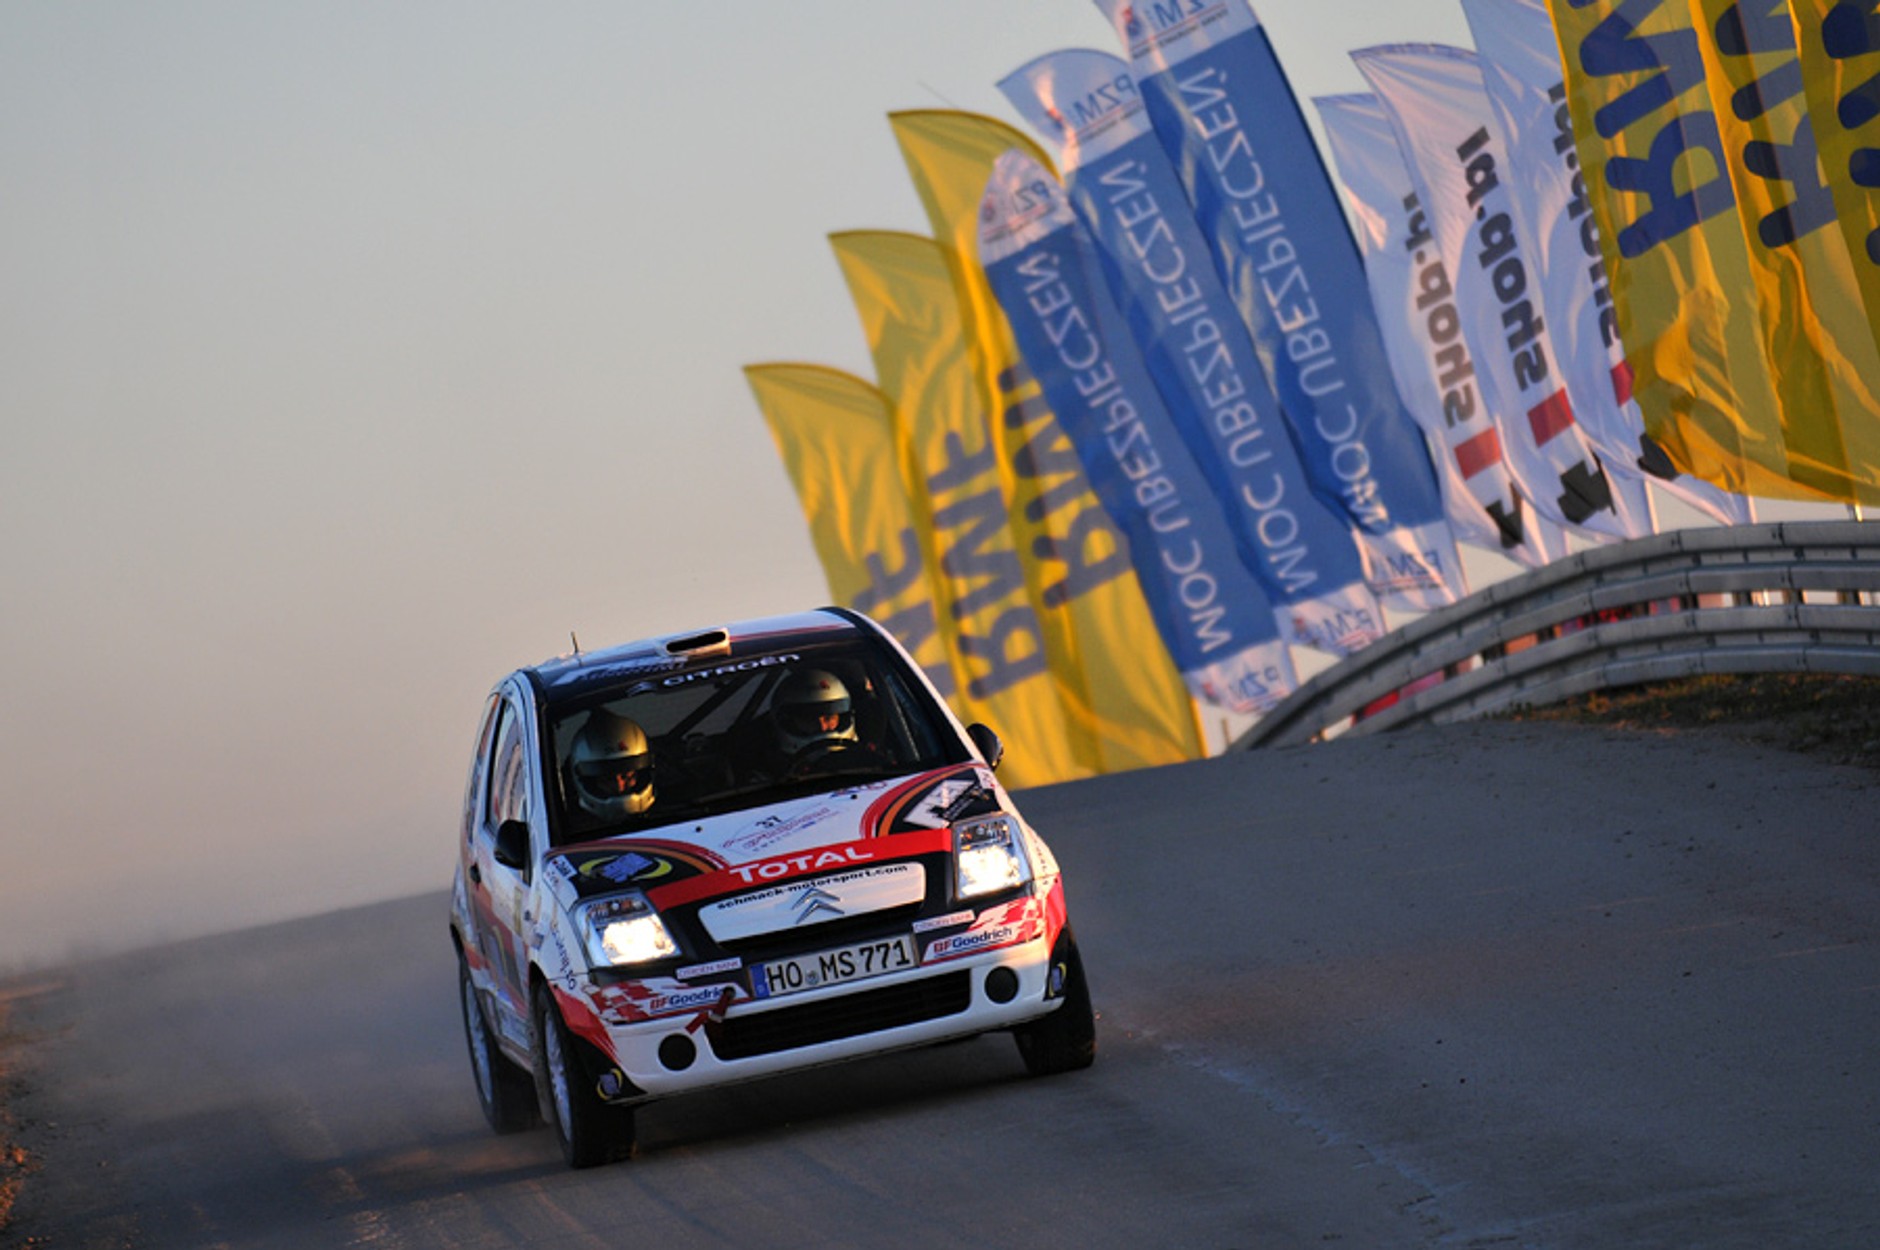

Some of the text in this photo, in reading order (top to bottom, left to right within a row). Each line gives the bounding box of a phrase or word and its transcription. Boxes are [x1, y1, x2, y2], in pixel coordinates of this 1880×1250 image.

[730, 847, 873, 883] TOTAL
[716, 865, 908, 911] schmack-motorsport.com
[933, 927, 1012, 953] BFGoodrich
[767, 939, 910, 992] HO MS 771
[650, 987, 723, 1011] BFGoodric
